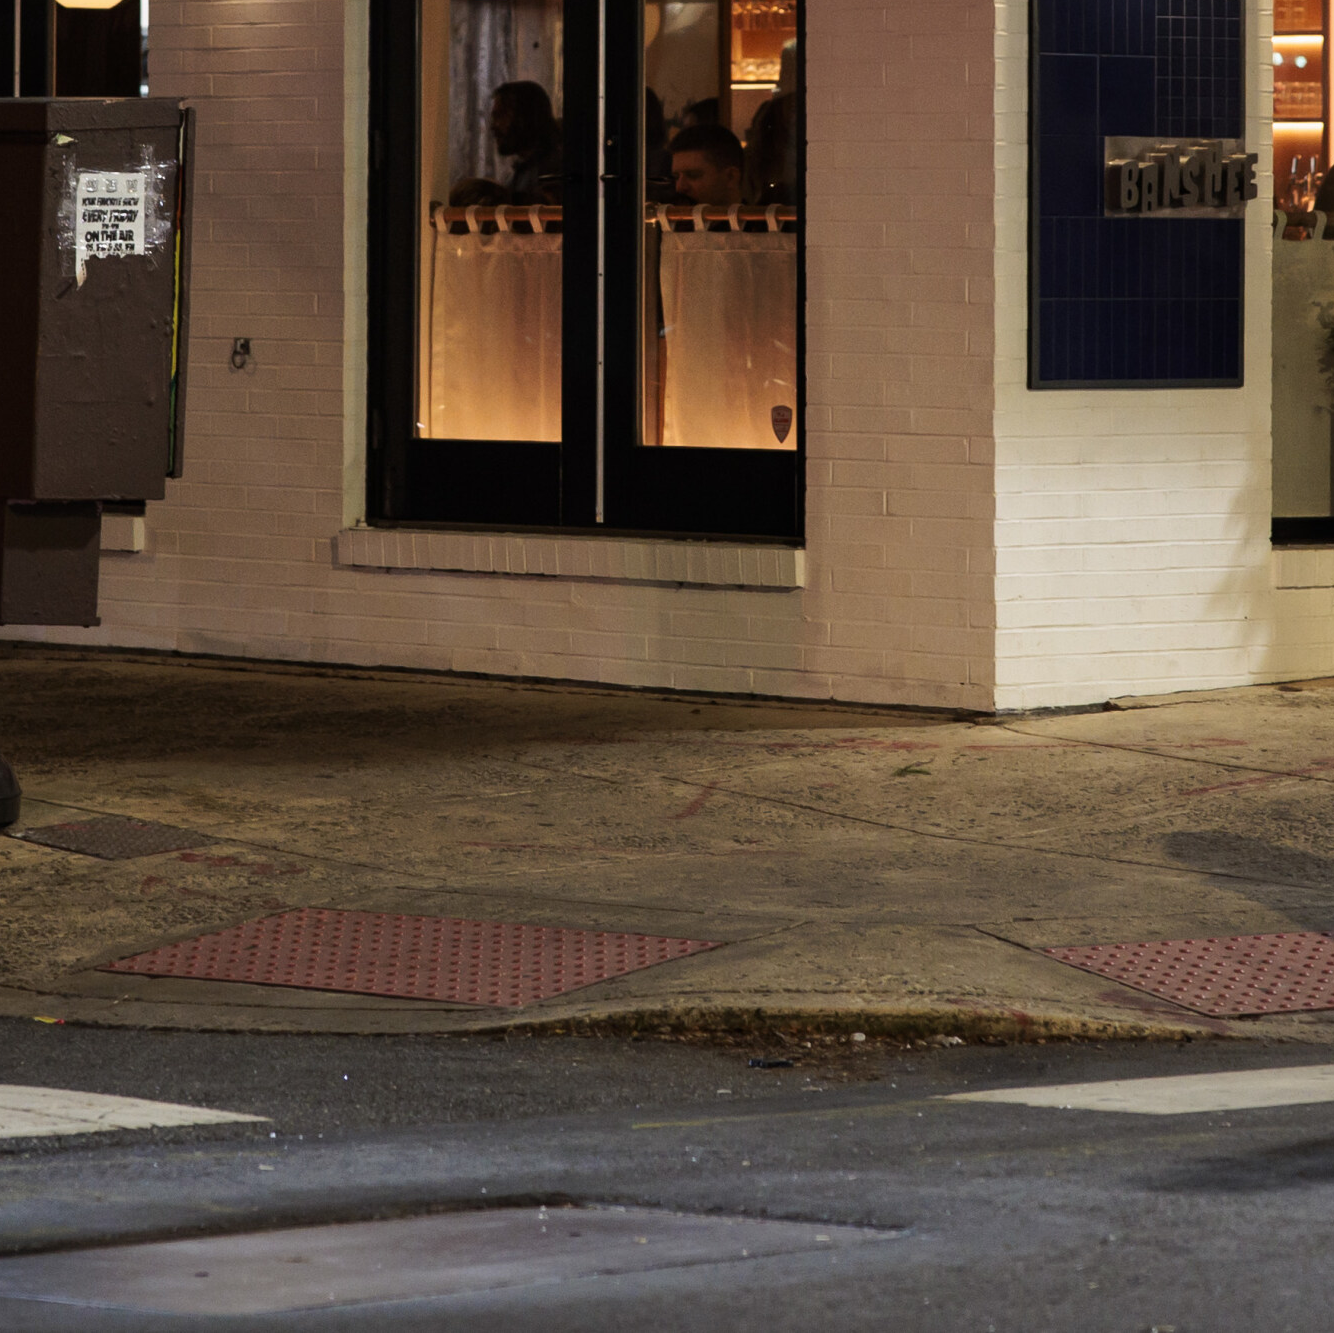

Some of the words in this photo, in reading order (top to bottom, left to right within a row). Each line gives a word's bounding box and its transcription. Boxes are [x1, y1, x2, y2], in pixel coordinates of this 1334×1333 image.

[1120, 140, 1259, 212] BANSHEE
[82, 210, 108, 223] EVERY
[85, 231, 99, 242] ON
[100, 230, 118, 242] THE
[119, 230, 134, 242] AIR
